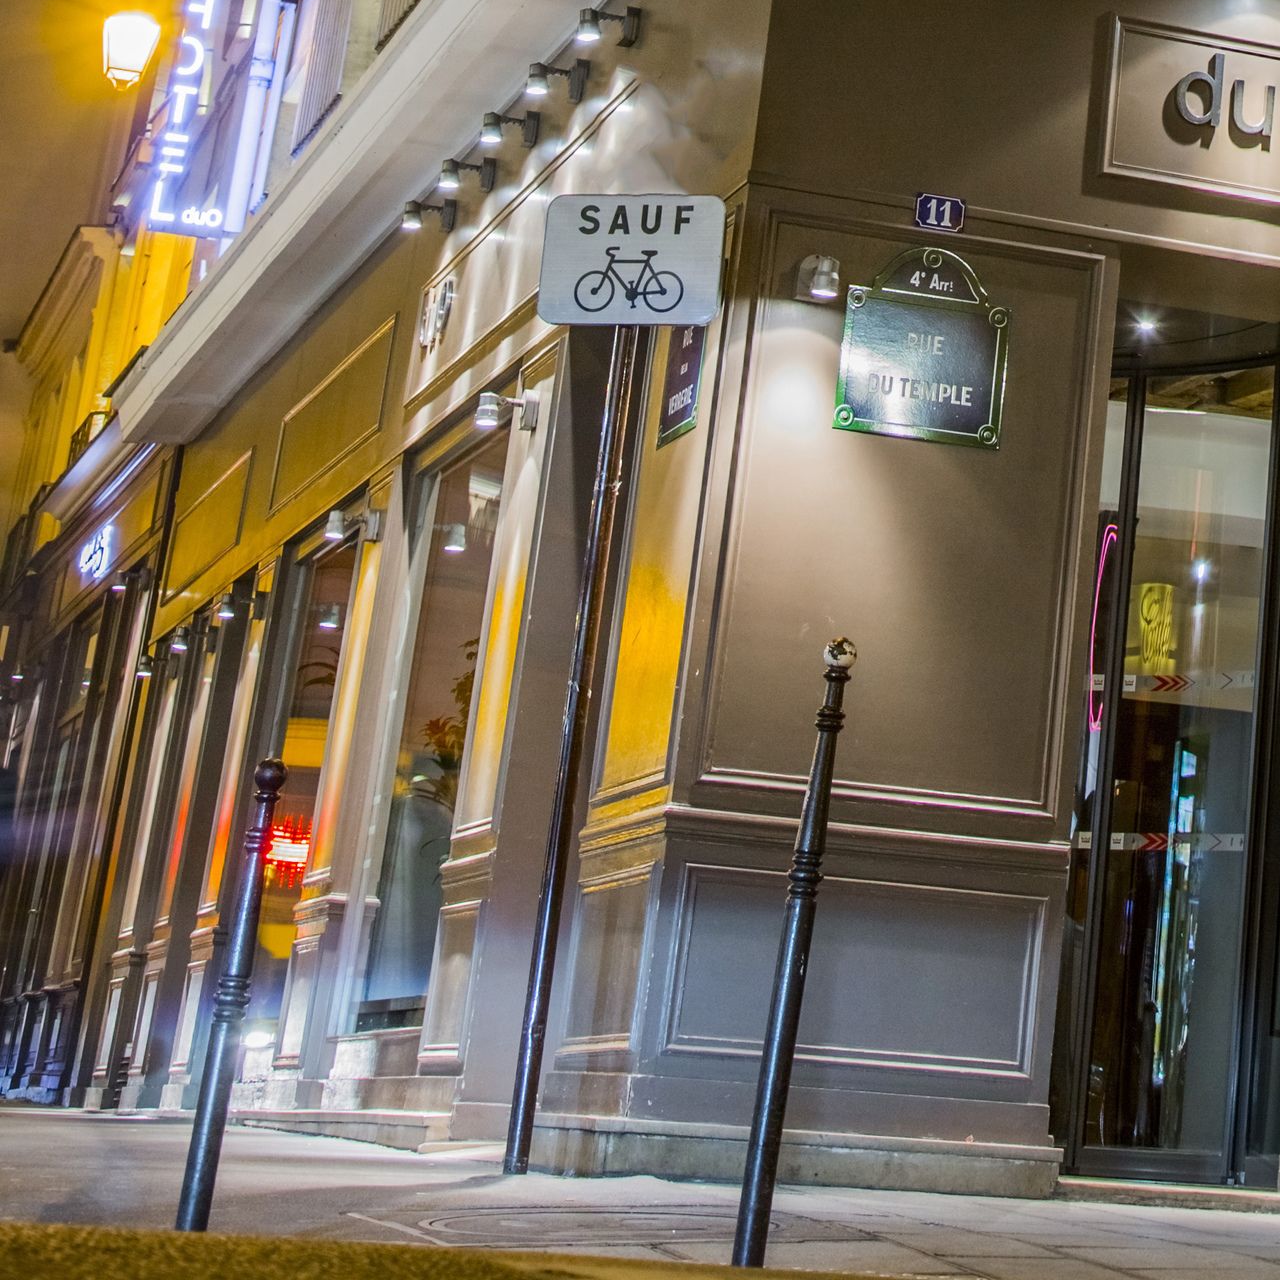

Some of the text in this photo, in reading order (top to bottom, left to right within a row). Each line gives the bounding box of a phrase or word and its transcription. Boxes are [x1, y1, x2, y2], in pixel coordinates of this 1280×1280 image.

[578, 204, 695, 236] SAUF
[926, 198, 953, 228] 11
[907, 332, 945, 356] RUE
[867, 372, 974, 407] DU TEMPLE
